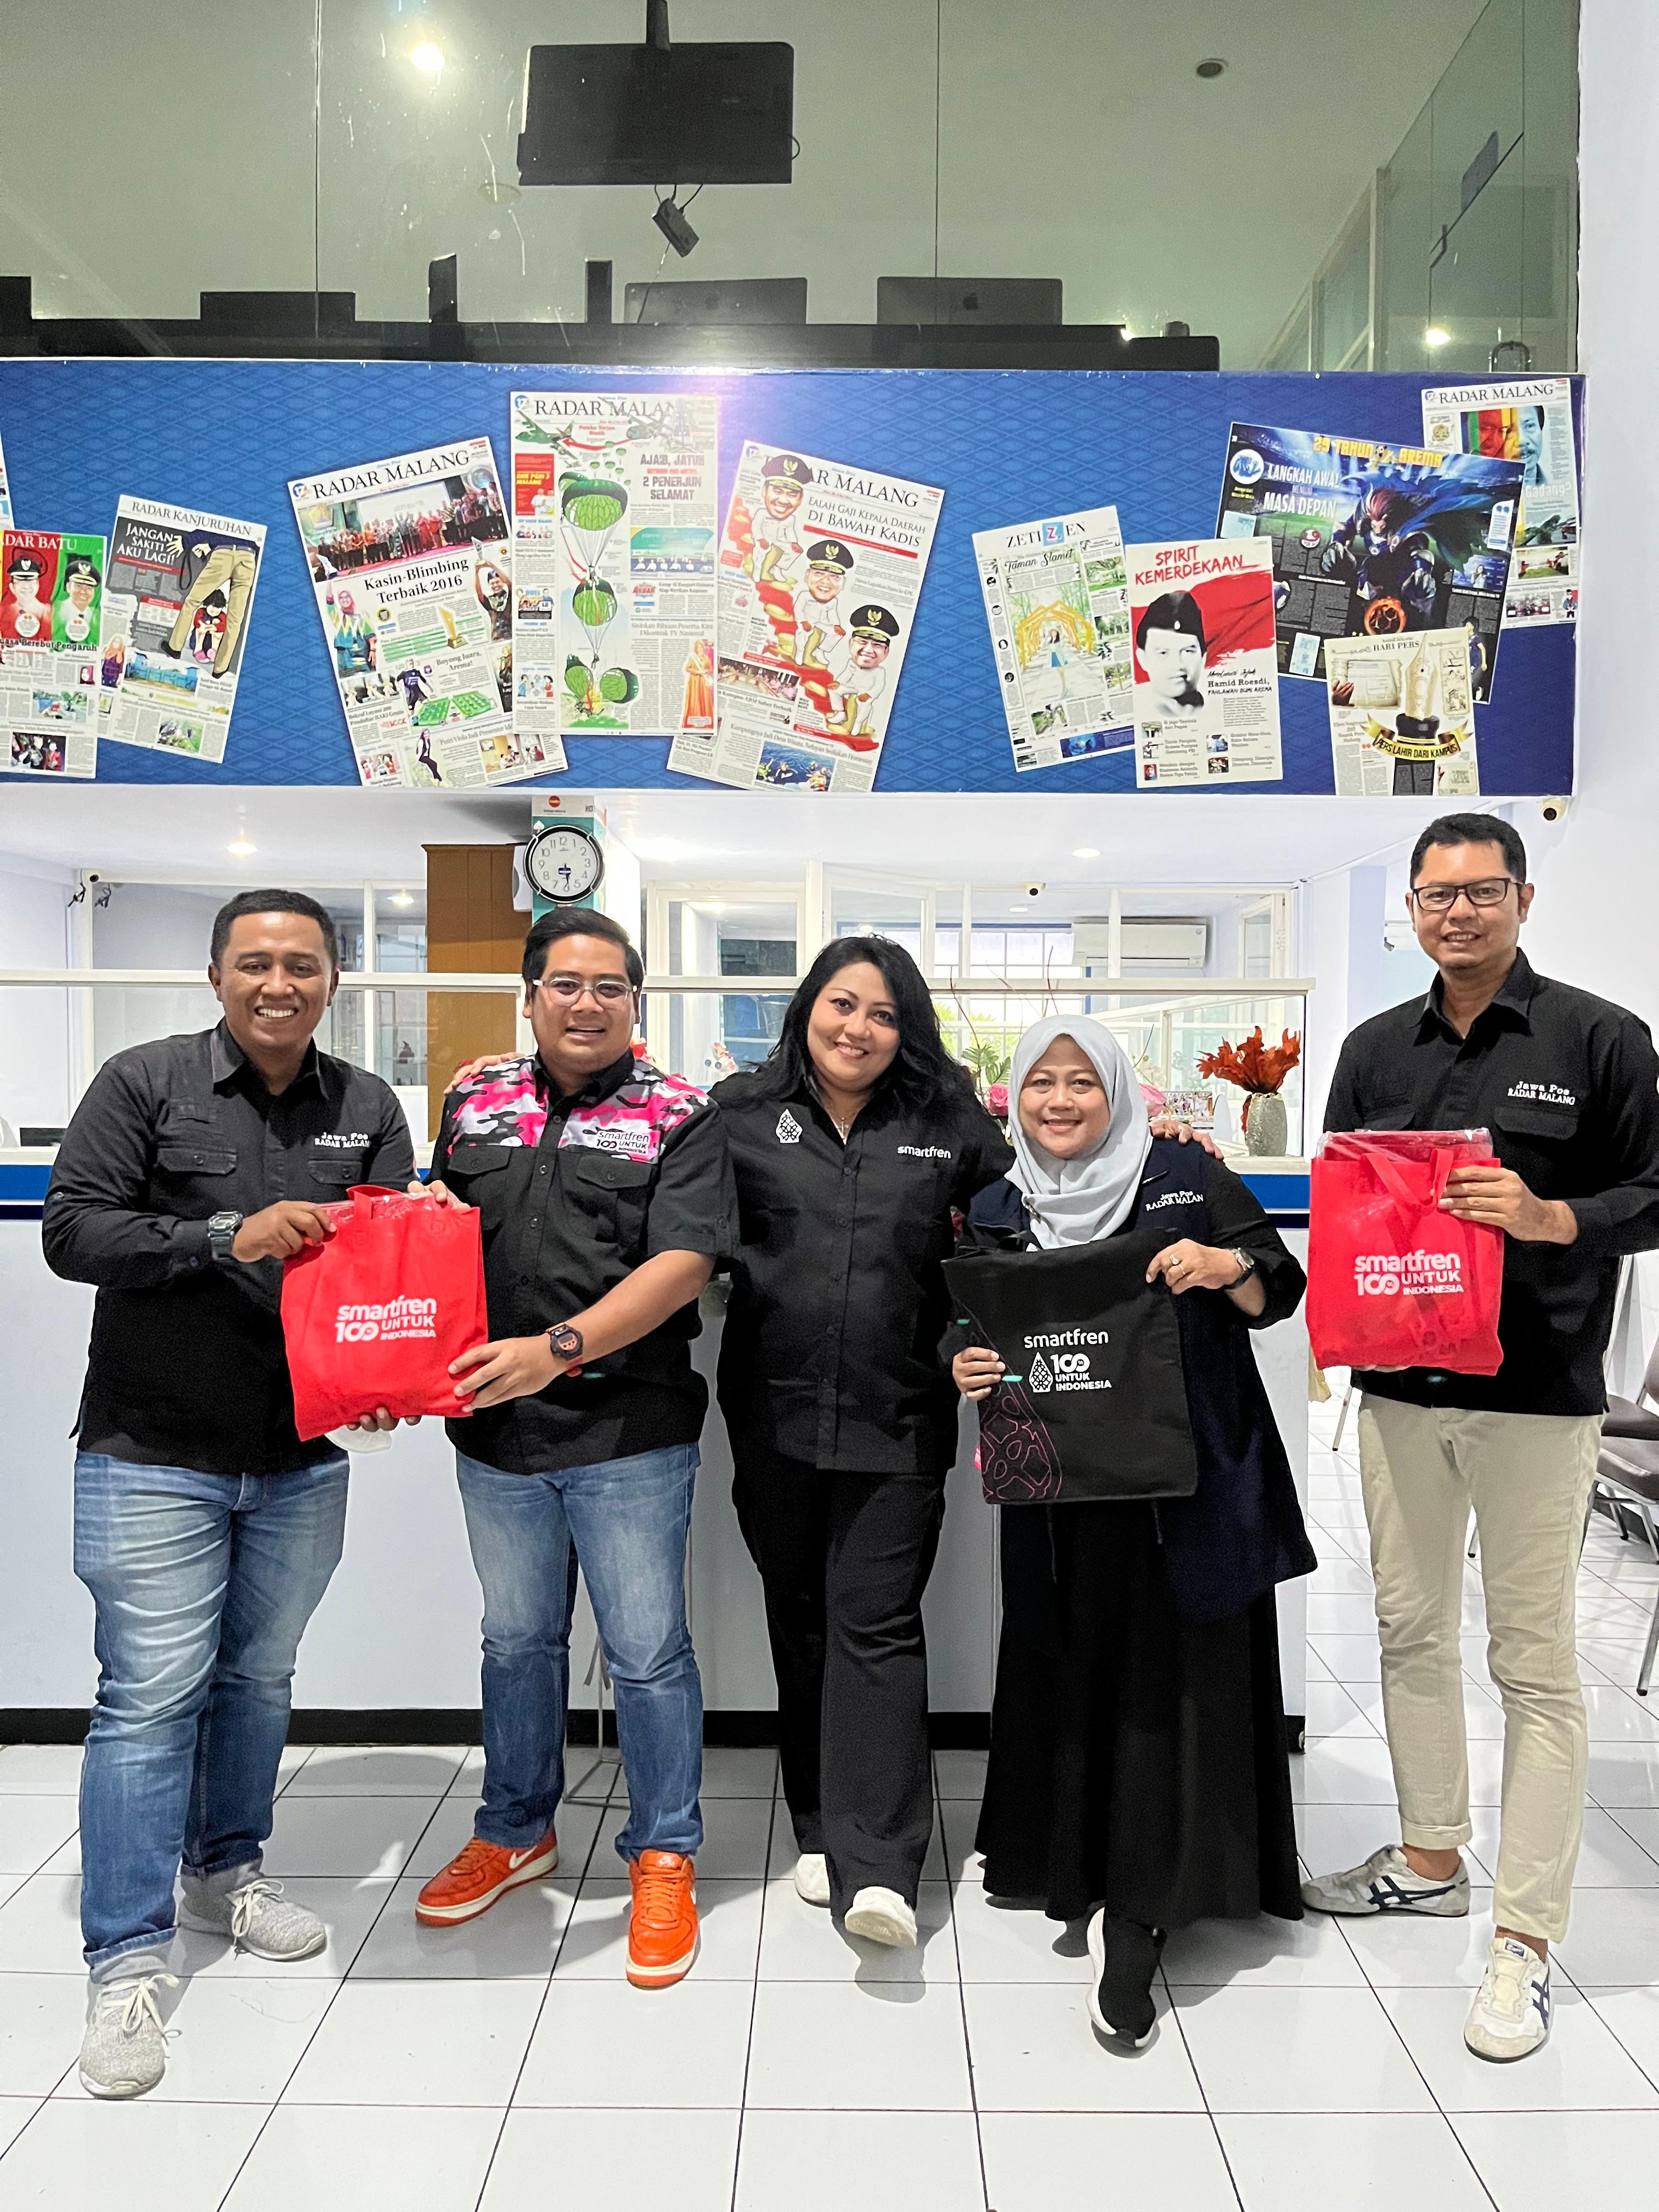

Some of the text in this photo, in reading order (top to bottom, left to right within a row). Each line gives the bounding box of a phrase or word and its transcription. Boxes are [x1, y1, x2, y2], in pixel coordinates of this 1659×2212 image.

[1440, 383, 1554, 404] RADAR MALANG
[535, 400, 603, 415] RADAR
[1313, 436, 1443, 468] 29 TAHUN AREMA
[312, 450, 470, 499] RADAR MALANG
[1268, 464, 1313, 485] LANGKAH
[643, 476, 702, 487] 2 PENERJUN
[651, 489, 695, 500] SELAMAT
[834, 473, 919, 507] MALANG
[1263, 492, 1296, 514] MASA
[1297, 496, 1336, 518] DEPAN
[132, 501, 252, 536] RADAR KANJURUHAN
[808, 510, 823, 523] DI
[126, 523, 173, 542] JANGAN
[38, 537, 78, 550] BATU
[131, 537, 164, 552] SAKITI
[117, 543, 142, 558] AKU
[144, 551, 175, 566] LAGI!
[1005, 558, 1037, 573] Taman
[1040, 548, 1075, 567] Slamet
[1155, 545, 1200, 566] SPIRIT
[364, 558, 469, 591] Kasin-Blimbing
[1135, 554, 1244, 585] KEMERDEKAAN
[376, 583, 428, 603] Terbaik
[430, 574, 462, 592] 2016
[22, 638, 54, 649] Berebut
[57, 641, 97, 651] Pengaruh
[1373, 641, 1420, 651] HARI PERS
[1376, 738, 1458, 758] PERS LAHIR DARI KAMPUS
[550, 840, 556, 848] 11
[559, 837, 567, 845] 12
[573, 839, 576, 848] 1
[541, 848, 550, 857] 10
[580, 847, 586, 856] 2
[538, 860, 545, 869] 9
[584, 858, 591, 868] 3
[543, 871, 549, 880] 8
[582, 870, 588, 878] 4
[552, 879, 558, 889] 7
[574, 879, 581, 888] 5
[1516, 1081, 1545, 1091] Jawa
[1508, 1088, 1576, 1105] RADAR MALANG
[314, 1138, 341, 1148] RADAR
[321, 1132, 348, 1141] Jawa
[599, 1131, 650, 1143] smartfren
[619, 1141, 647, 1149] UNTUK
[898, 1146, 952, 1159] smartfren
[1146, 1197, 1175, 1211] RADAR
[1355, 1249, 1462, 1272] smartfren
[1353, 1269, 1462, 1296] 100 UNTUK
[1403, 1284, 1465, 1296] INDONESIA
[337, 1294, 437, 1321] smartfren
[334, 1315, 435, 1343] 100 UNTUK
[380, 1329, 437, 1341] INDONESIA
[1024, 1328, 1109, 1349] smartfren
[1049, 1353, 1091, 1374] 100
[1054, 1372, 1091, 1383] UNTUK
[1055, 1379, 1113, 1392] INDONESIA
